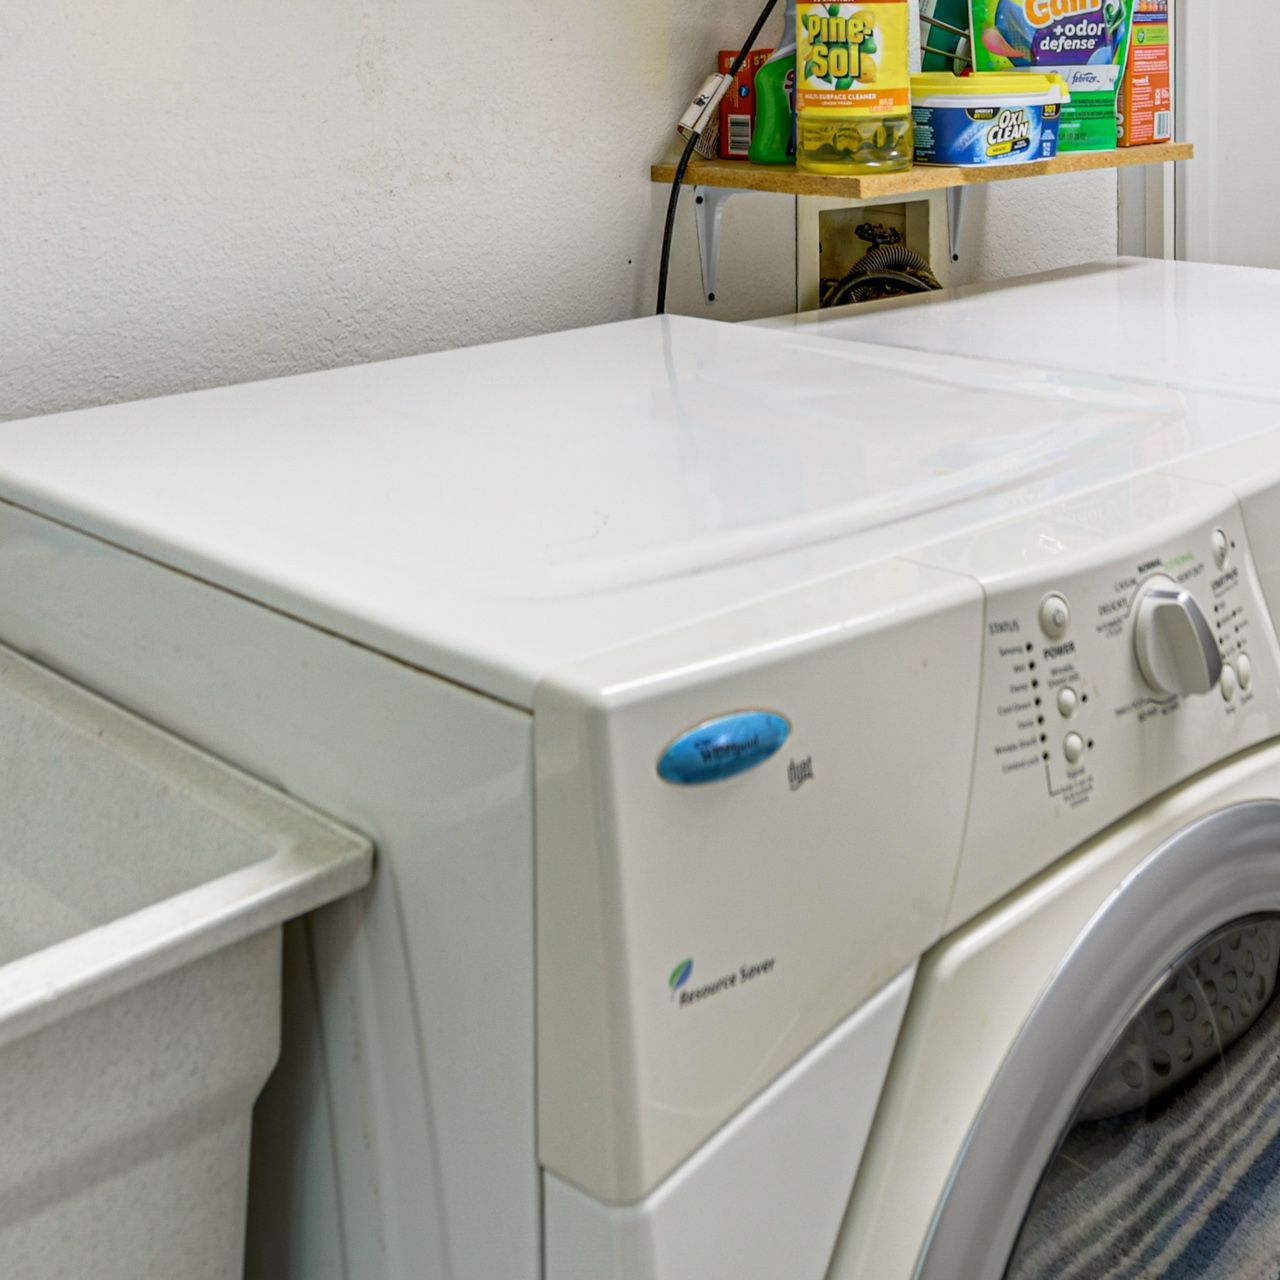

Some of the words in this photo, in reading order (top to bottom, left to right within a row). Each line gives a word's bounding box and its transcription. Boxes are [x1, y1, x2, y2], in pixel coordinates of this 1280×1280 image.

[1040, 36, 1096, 53] defense
[812, 43, 862, 79] Sol
[999, 109, 1024, 129] OXI
[987, 121, 1029, 146] CLEAN
[988, 619, 1020, 636] STATUS
[1043, 640, 1076, 660] POWER
[679, 971, 737, 1010] Resource
[739, 957, 776, 984] Saver
